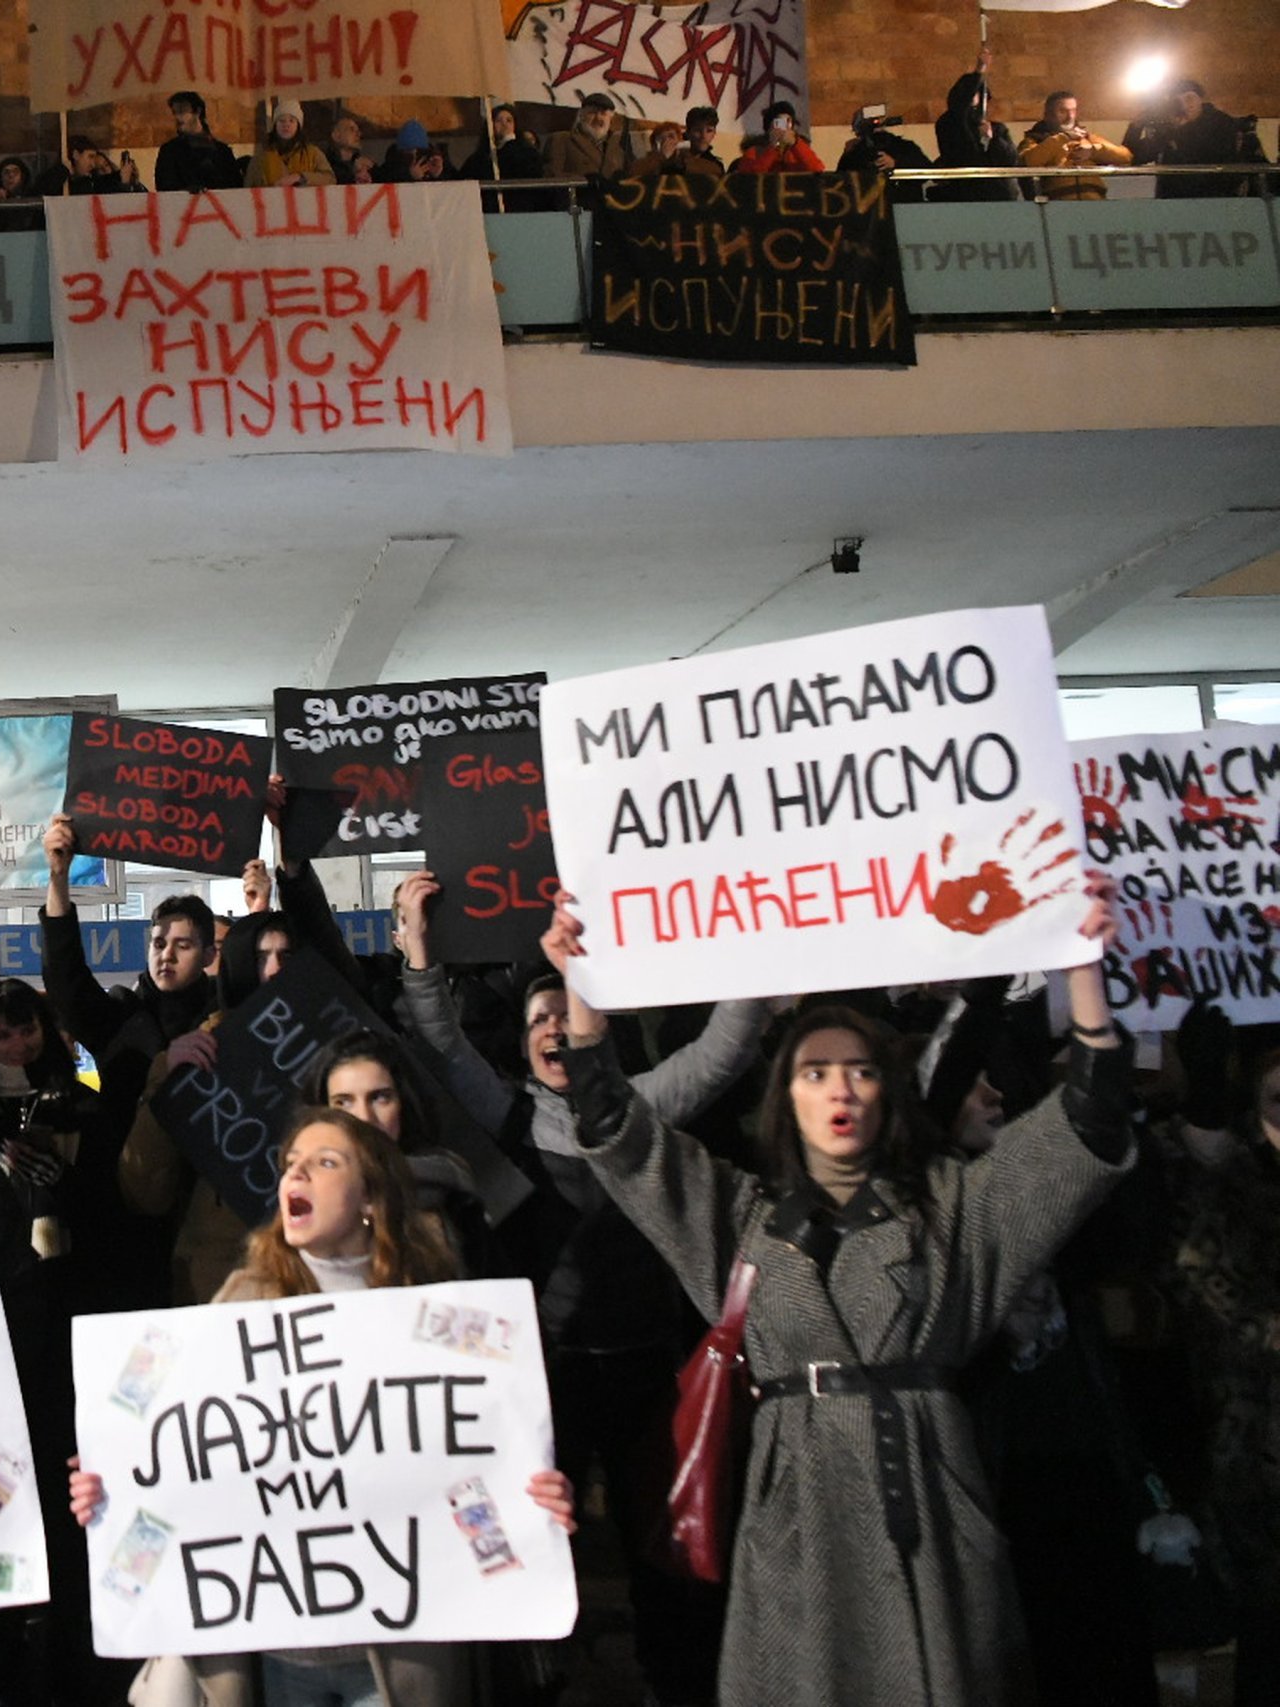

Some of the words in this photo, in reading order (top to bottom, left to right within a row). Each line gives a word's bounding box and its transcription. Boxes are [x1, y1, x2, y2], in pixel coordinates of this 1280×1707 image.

[68, 11, 419, 96] УХАПШЕНИ!
[91, 183, 404, 260] НАШИ
[605, 171, 888, 219] ЗАХТЕВИ
[1066, 231, 1260, 276] ЦЕНТАР
[62, 266, 431, 323] ЗАХТЕВИ
[604, 274, 897, 349] ИСПУЊЕНИ
[147, 319, 402, 379] НИСУ
[76, 379, 486, 454] ИСПУЊЕНИ
[303, 686, 481, 726] SLOBODNI
[394, 716, 458, 743] ako
[575, 703, 670, 766] МИ
[697, 644, 997, 745] ПЛАЋАМО
[84, 719, 253, 766] SLOBODA
[446, 754, 542, 793] Glas
[608, 773, 744, 855] АЛИ
[767, 732, 1020, 833] НИСМО
[1117, 748, 1208, 801] МИ
[74, 791, 224, 834] SLOBODA
[91, 829, 225, 862] NARODU
[611, 852, 936, 948] ПЛАЋЕНИ
[1116, 858, 1204, 903] ОЈА
[1103, 946, 1280, 1009] ВАШИХ
[237, 1302, 343, 1383] НЕ
[132, 1375, 495, 1488] ЛАЖИТЕ
[254, 1467, 348, 1517] МИ
[181, 1515, 419, 1630] БАБУ
